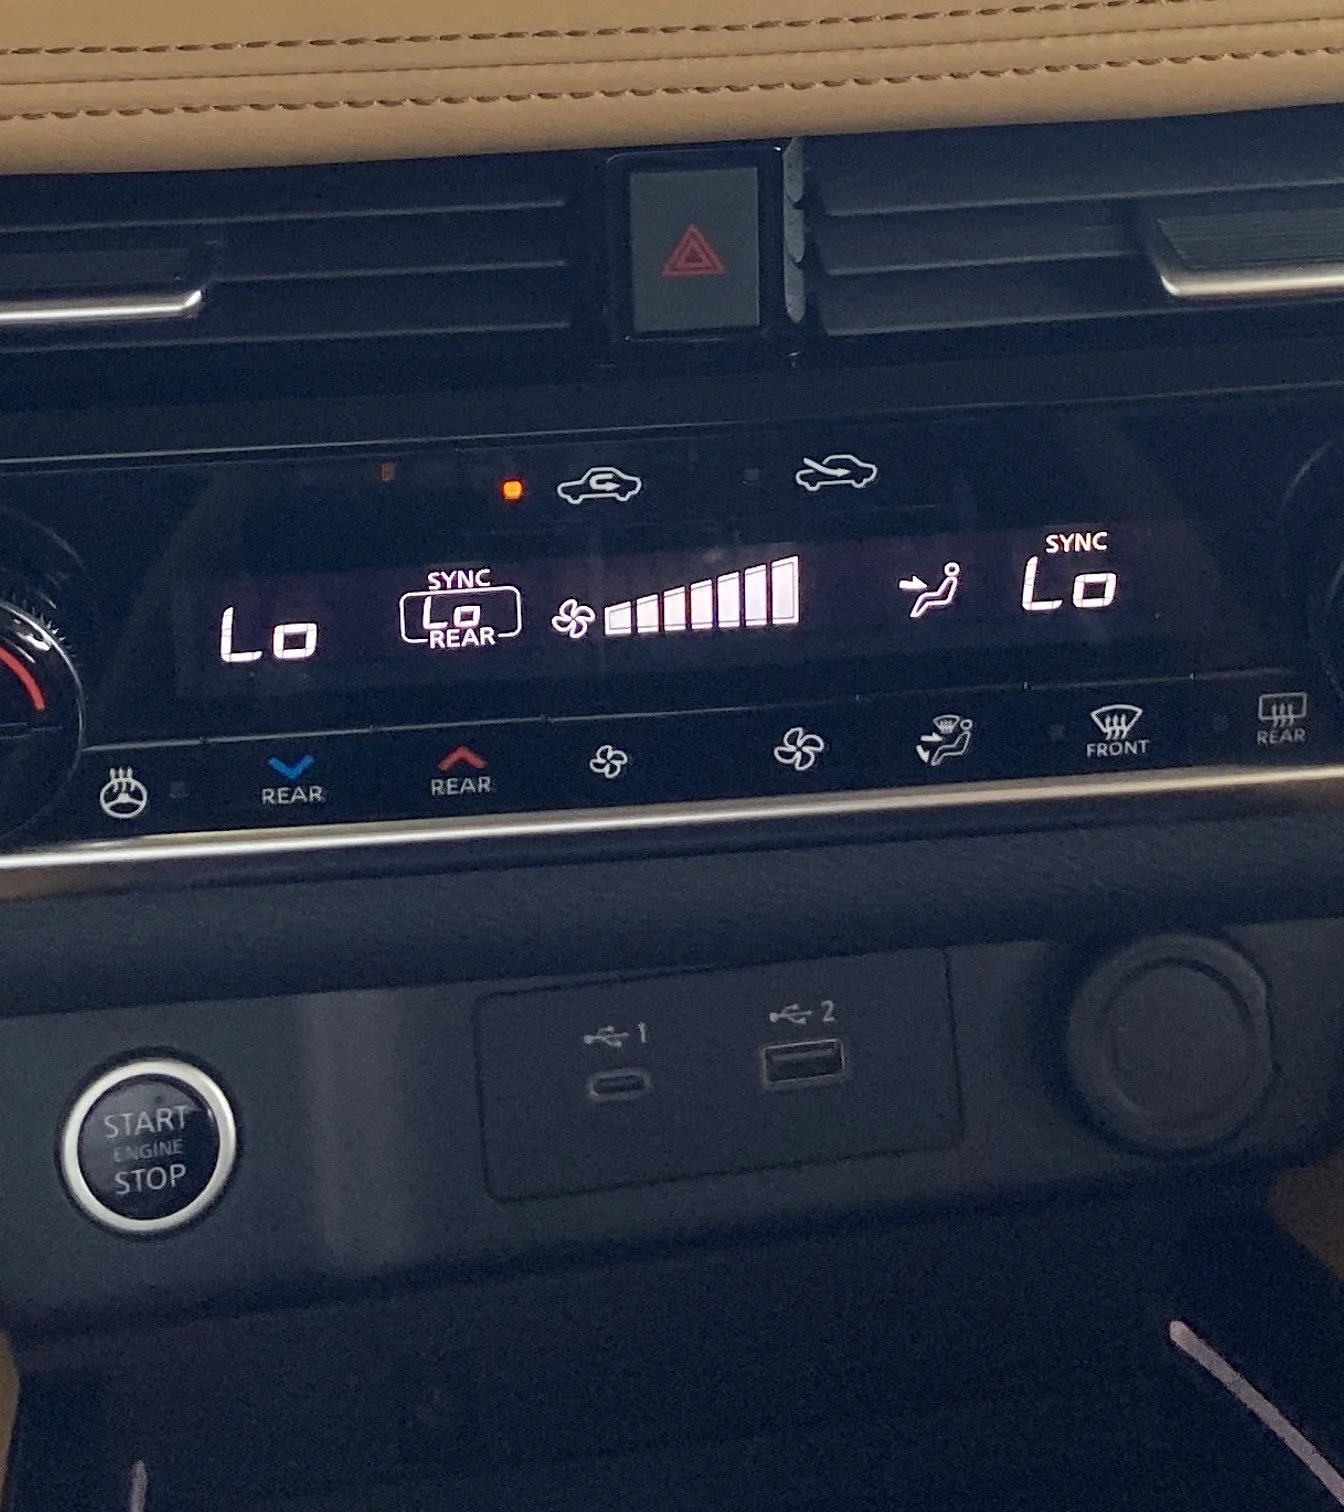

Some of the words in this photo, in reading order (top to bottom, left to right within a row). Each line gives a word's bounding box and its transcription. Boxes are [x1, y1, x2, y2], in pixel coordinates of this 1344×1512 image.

[1046, 532, 1108, 553] SYNC
[427, 569, 491, 590] SYNC
[1022, 556, 1118, 611] Lo
[220, 606, 318, 662] Lo
[429, 627, 495, 649] REAR
[1257, 728, 1306, 745] REAR
[1086, 739, 1150, 757] FRONT
[262, 786, 324, 805] REAR
[431, 776, 491, 795] REAR
[821, 1000, 836, 1022] 2
[637, 1022, 648, 1044] 1
[104, 1105, 189, 1139] START
[114, 1139, 184, 1163] ENGINE
[115, 1164, 187, 1196] STOP
